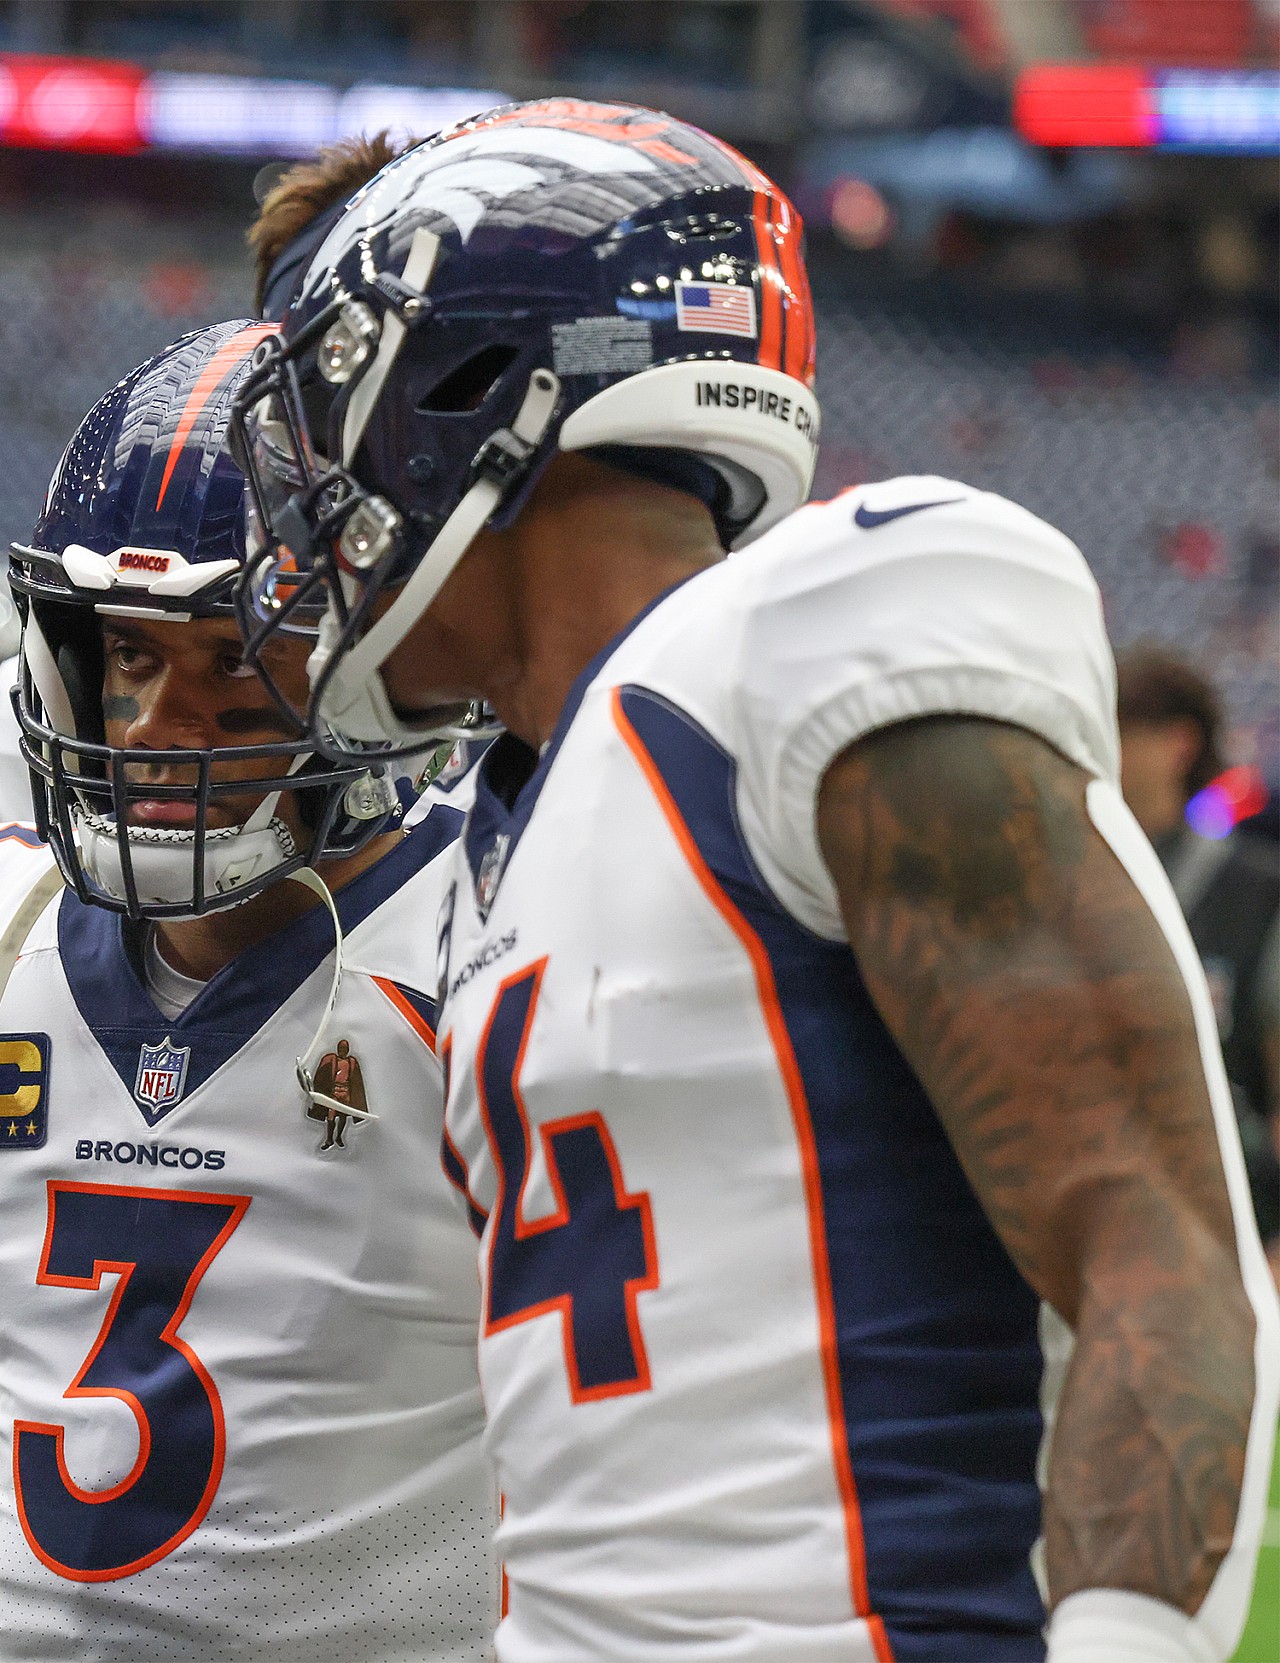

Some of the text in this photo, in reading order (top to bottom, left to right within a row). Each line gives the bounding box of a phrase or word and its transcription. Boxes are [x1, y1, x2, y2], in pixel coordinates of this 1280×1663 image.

[696, 381, 791, 422] INSPIRE
[119, 552, 170, 573] BRONCOS
[141, 1070, 174, 1100] NFL
[75, 1139, 226, 1171] BRONCOS
[13, 1179, 253, 1583] 3
